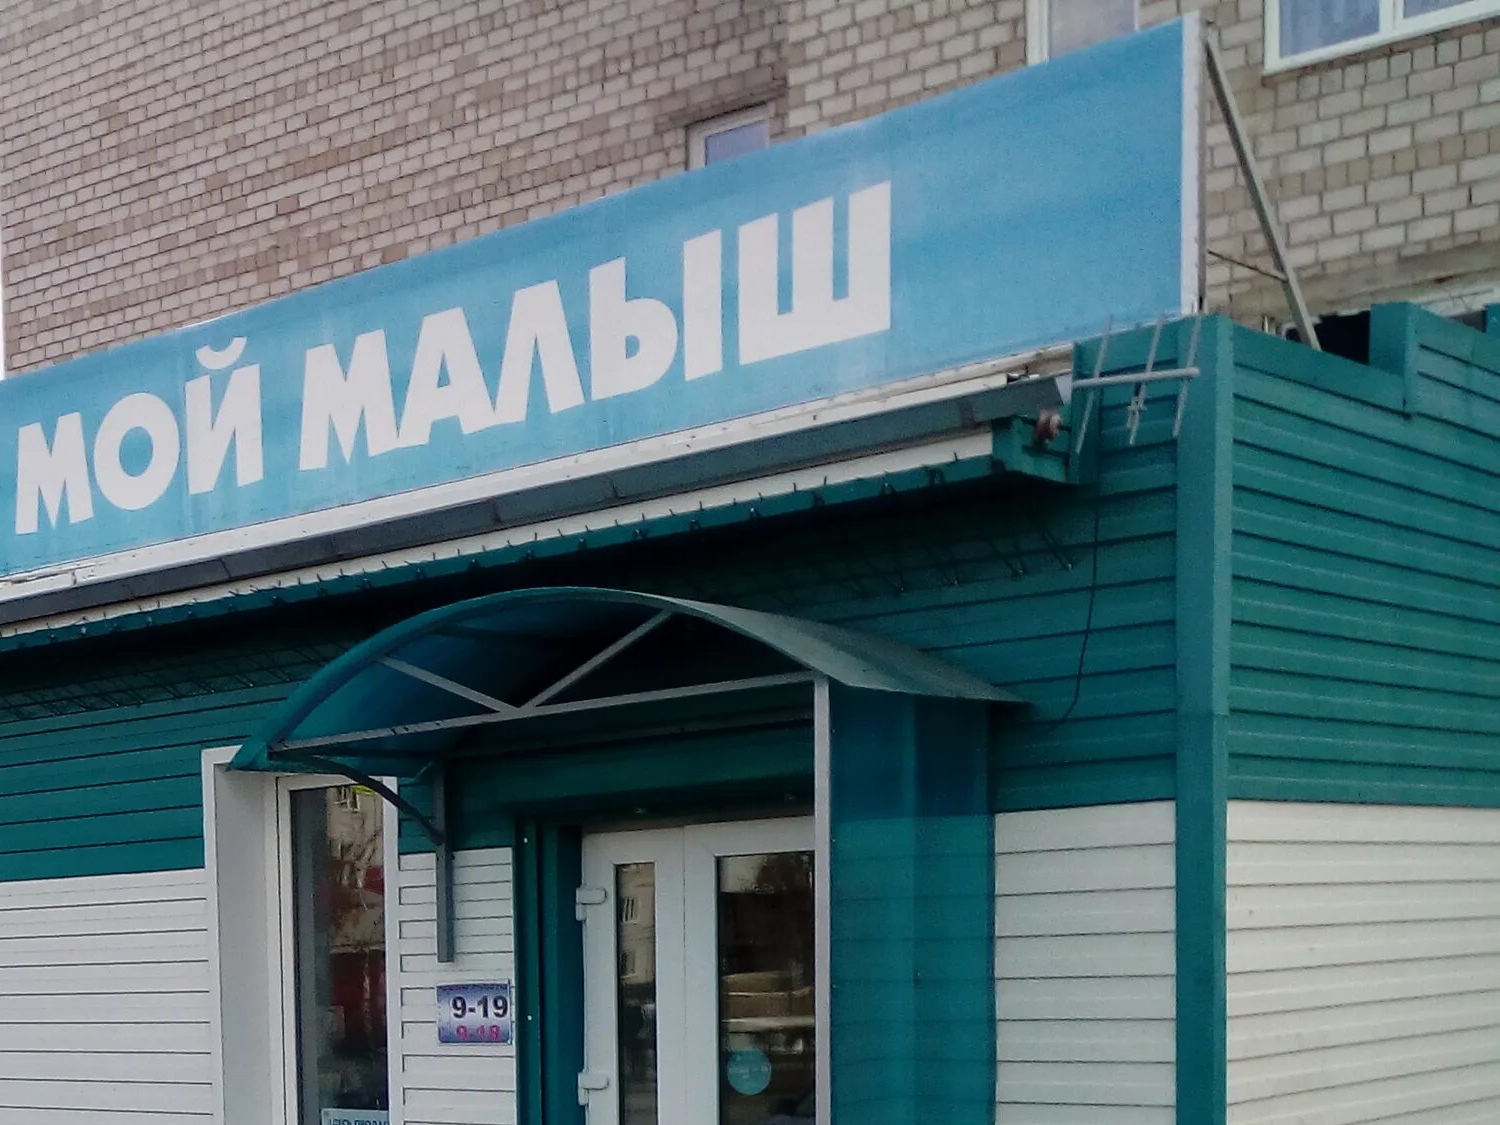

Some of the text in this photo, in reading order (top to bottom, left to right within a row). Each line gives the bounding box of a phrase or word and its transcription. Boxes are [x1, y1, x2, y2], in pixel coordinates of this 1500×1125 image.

[14, 180, 892, 536] МОЙ МАЛЫШ
[451, 995, 509, 1019] 9-19
